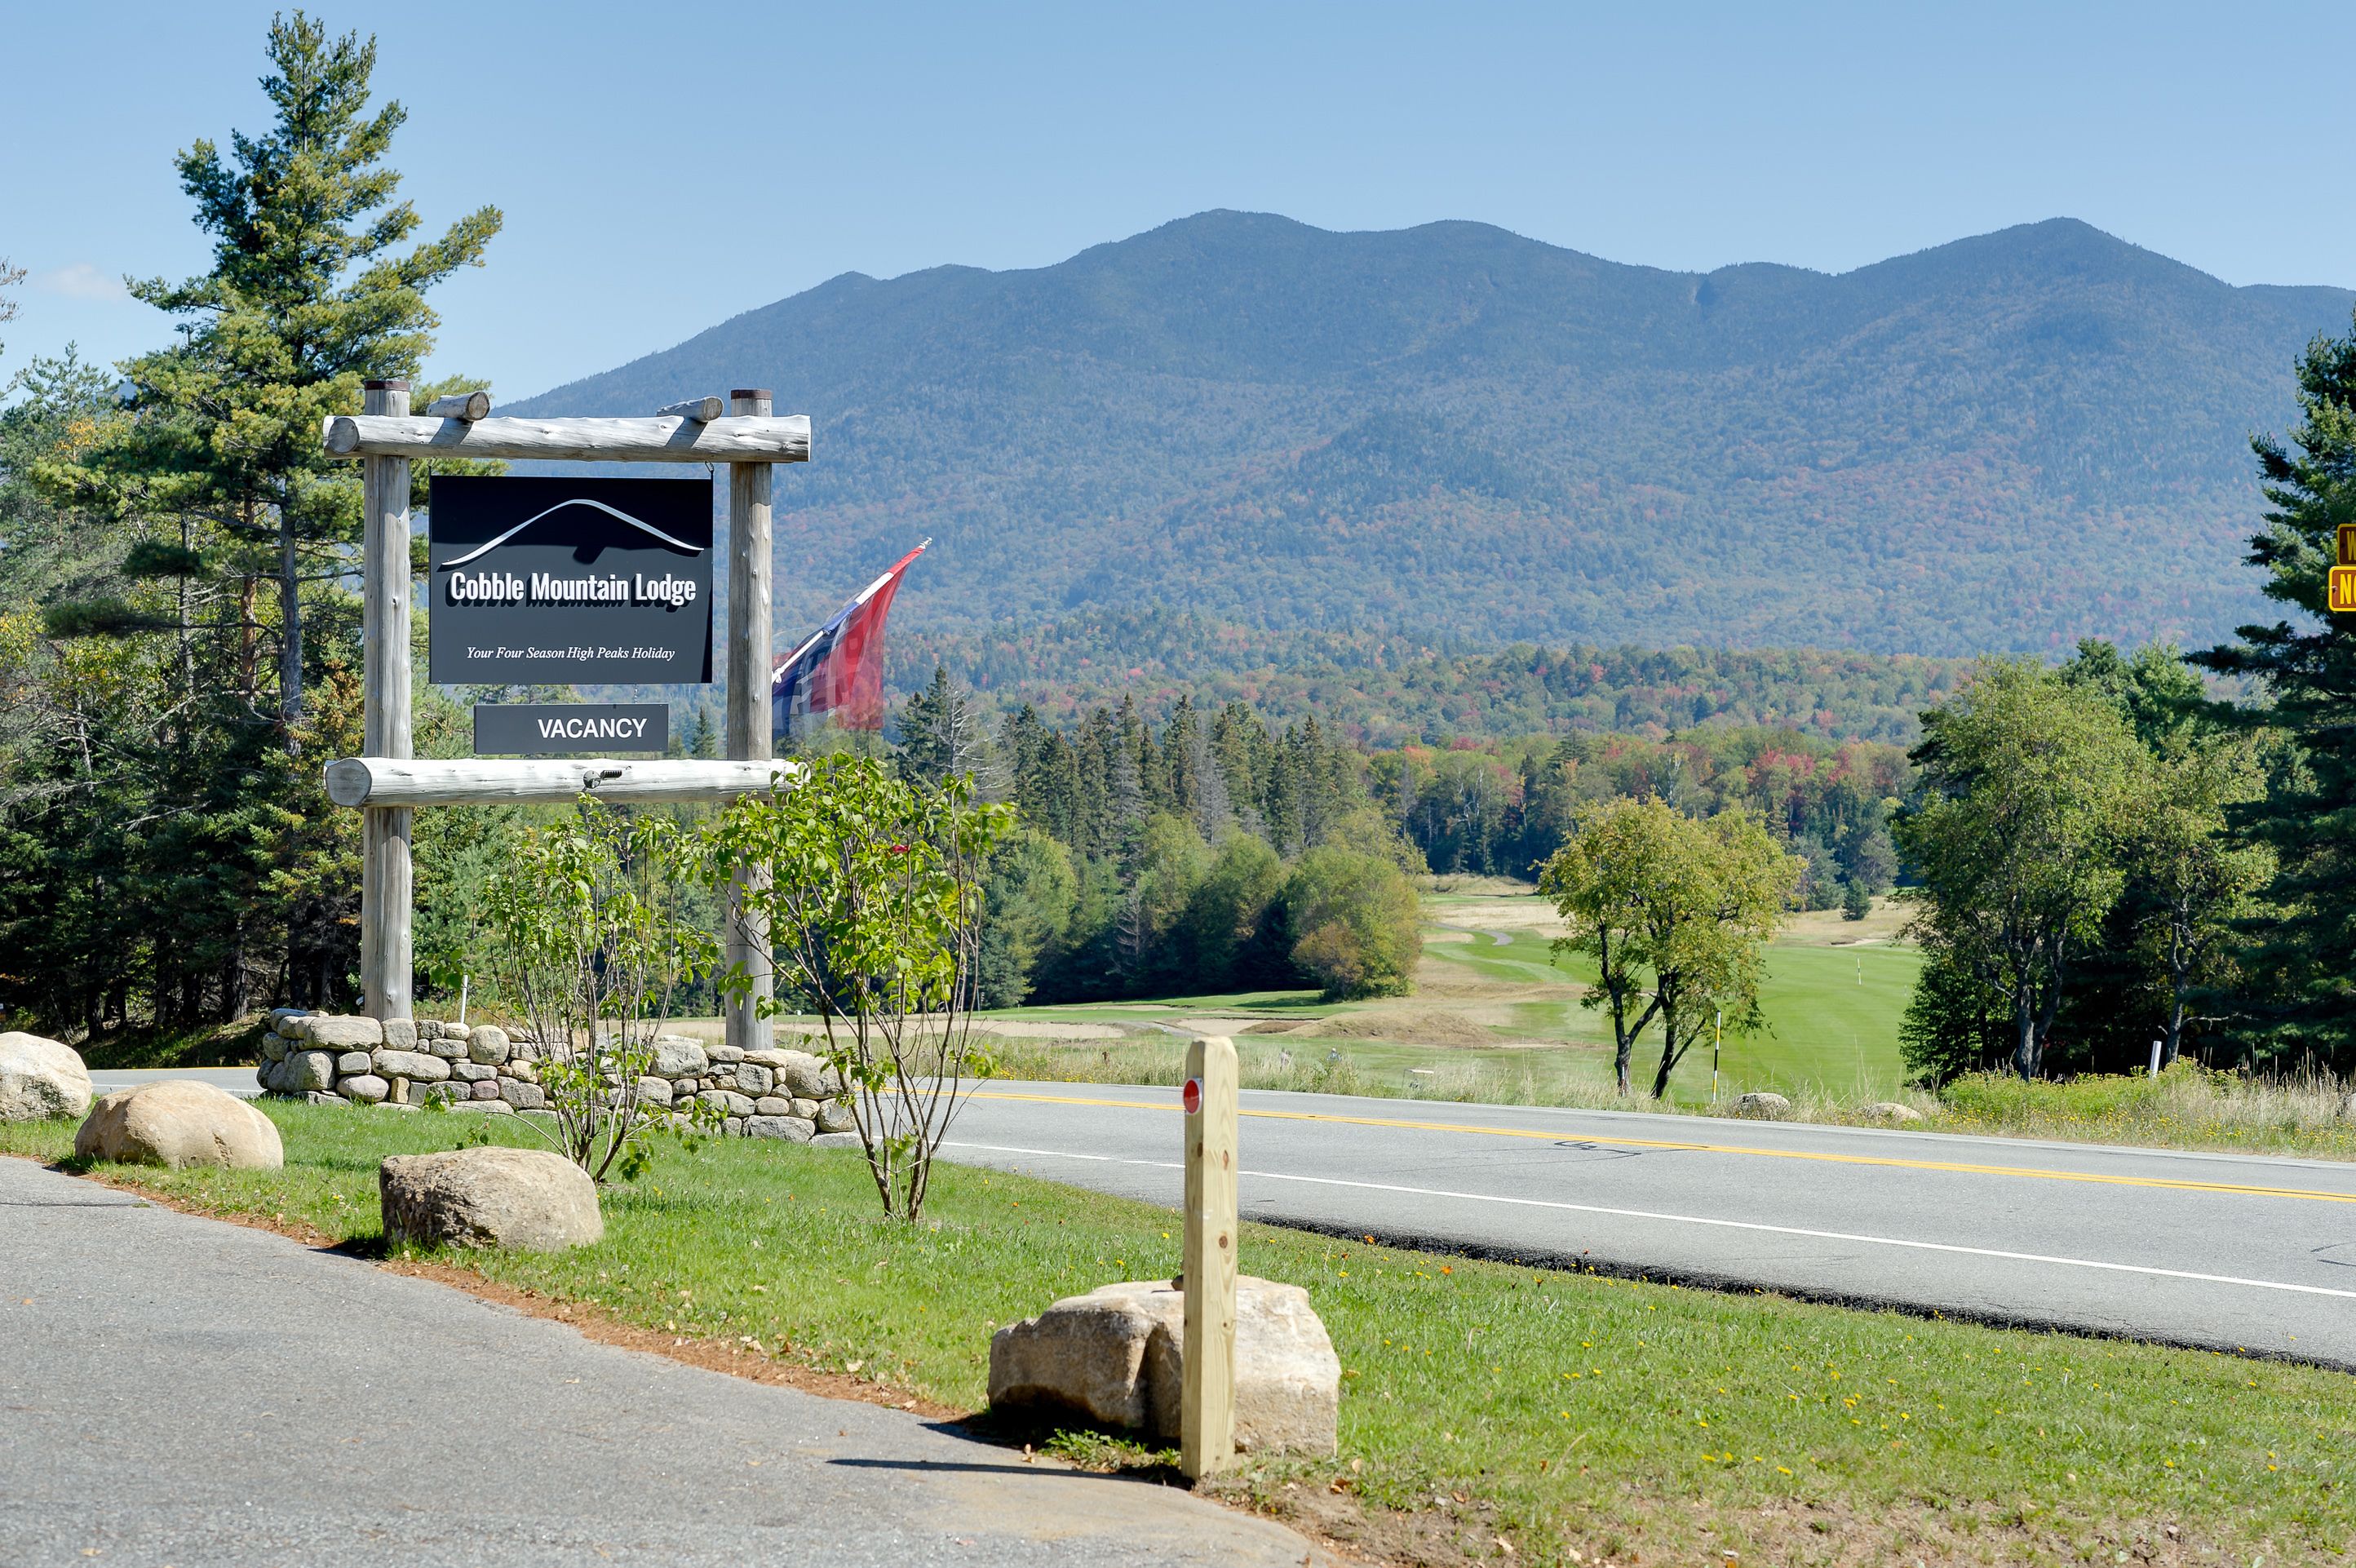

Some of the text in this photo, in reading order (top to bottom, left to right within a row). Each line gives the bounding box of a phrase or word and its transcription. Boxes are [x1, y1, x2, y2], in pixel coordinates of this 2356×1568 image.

[450, 571, 697, 606] Cobble Mountain Lodge
[467, 646, 675, 662] Your Four Season High Peaks Holiday
[537, 717, 649, 739] VACANCY
